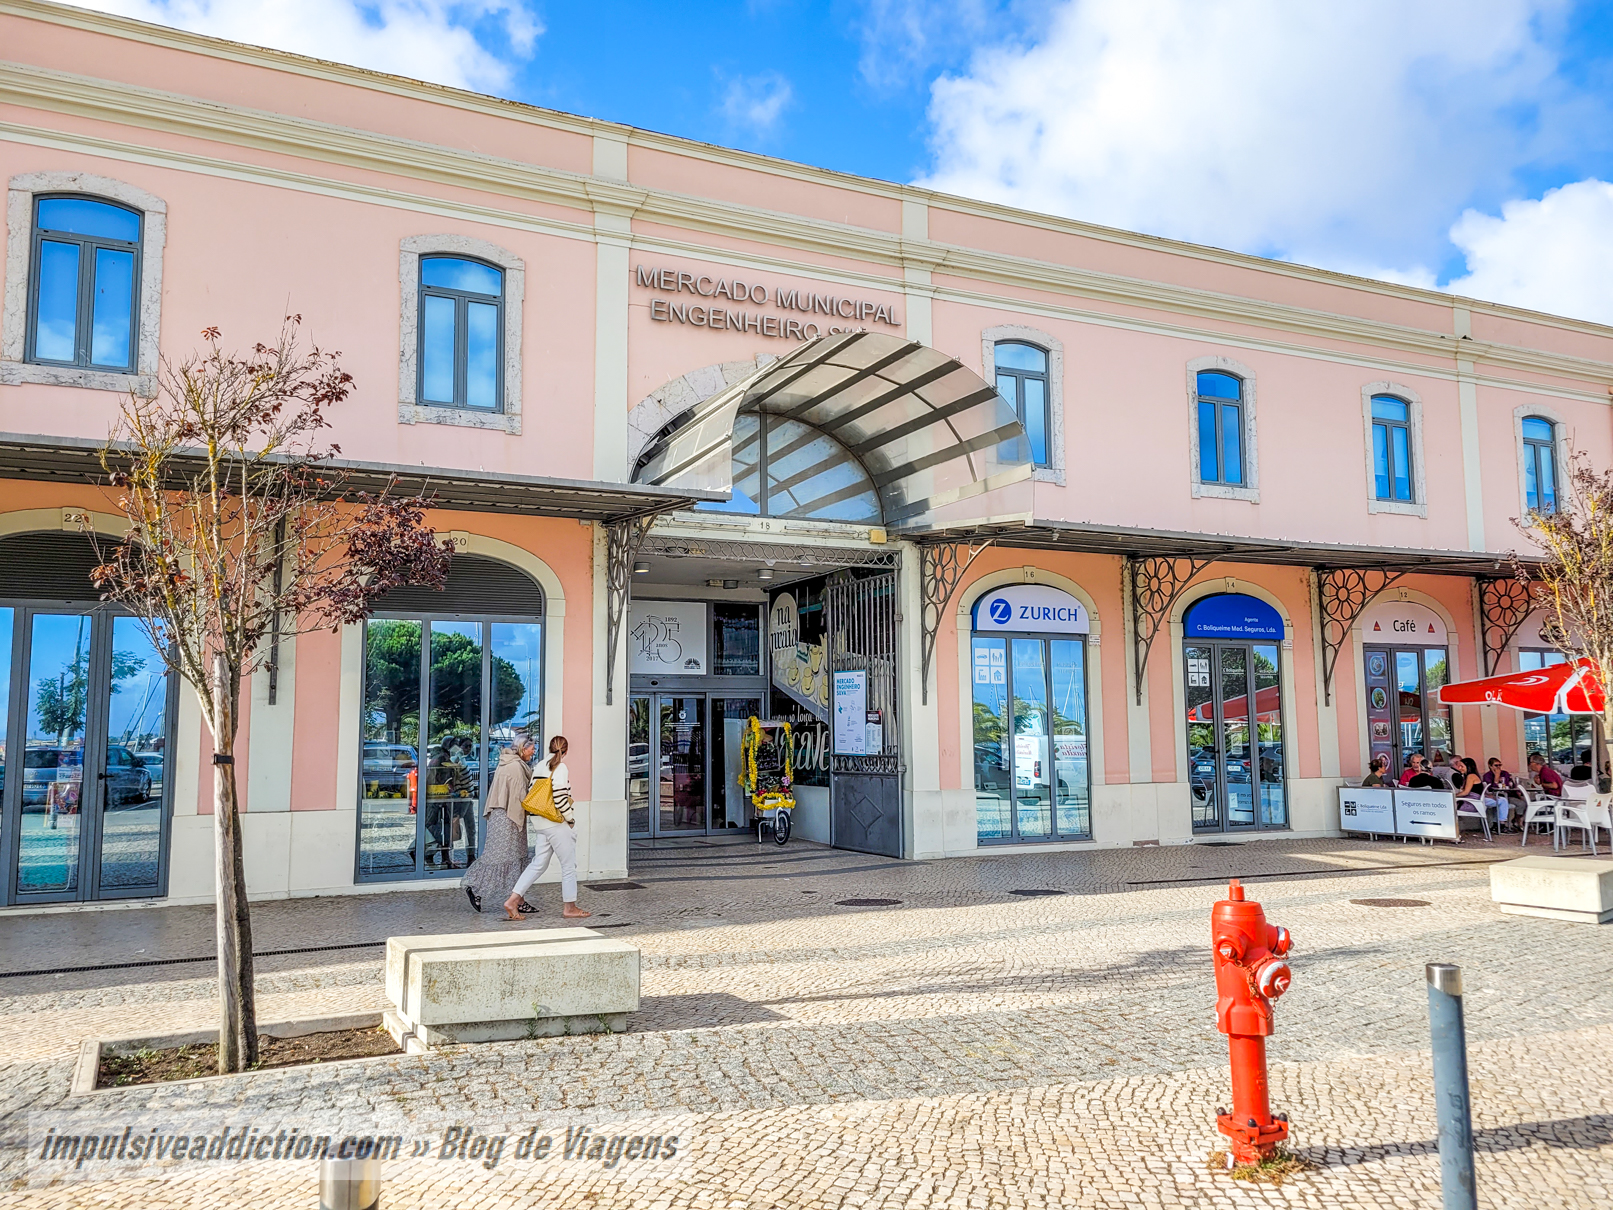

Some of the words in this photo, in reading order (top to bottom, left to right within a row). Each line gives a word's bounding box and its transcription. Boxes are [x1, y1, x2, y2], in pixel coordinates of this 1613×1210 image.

[636, 264, 769, 304] MERCADO
[776, 287, 901, 326] MUNICIPAL
[650, 298, 820, 341] ENGENHEIRO
[760, 521, 771, 530] 18
[453, 536, 467, 546] 20
[777, 605, 791, 626] na
[1019, 605, 1078, 622] ZURICH
[1203, 624, 1231, 632] Boliqueime
[1393, 619, 1416, 632] Café
[770, 624, 797, 654] praia
